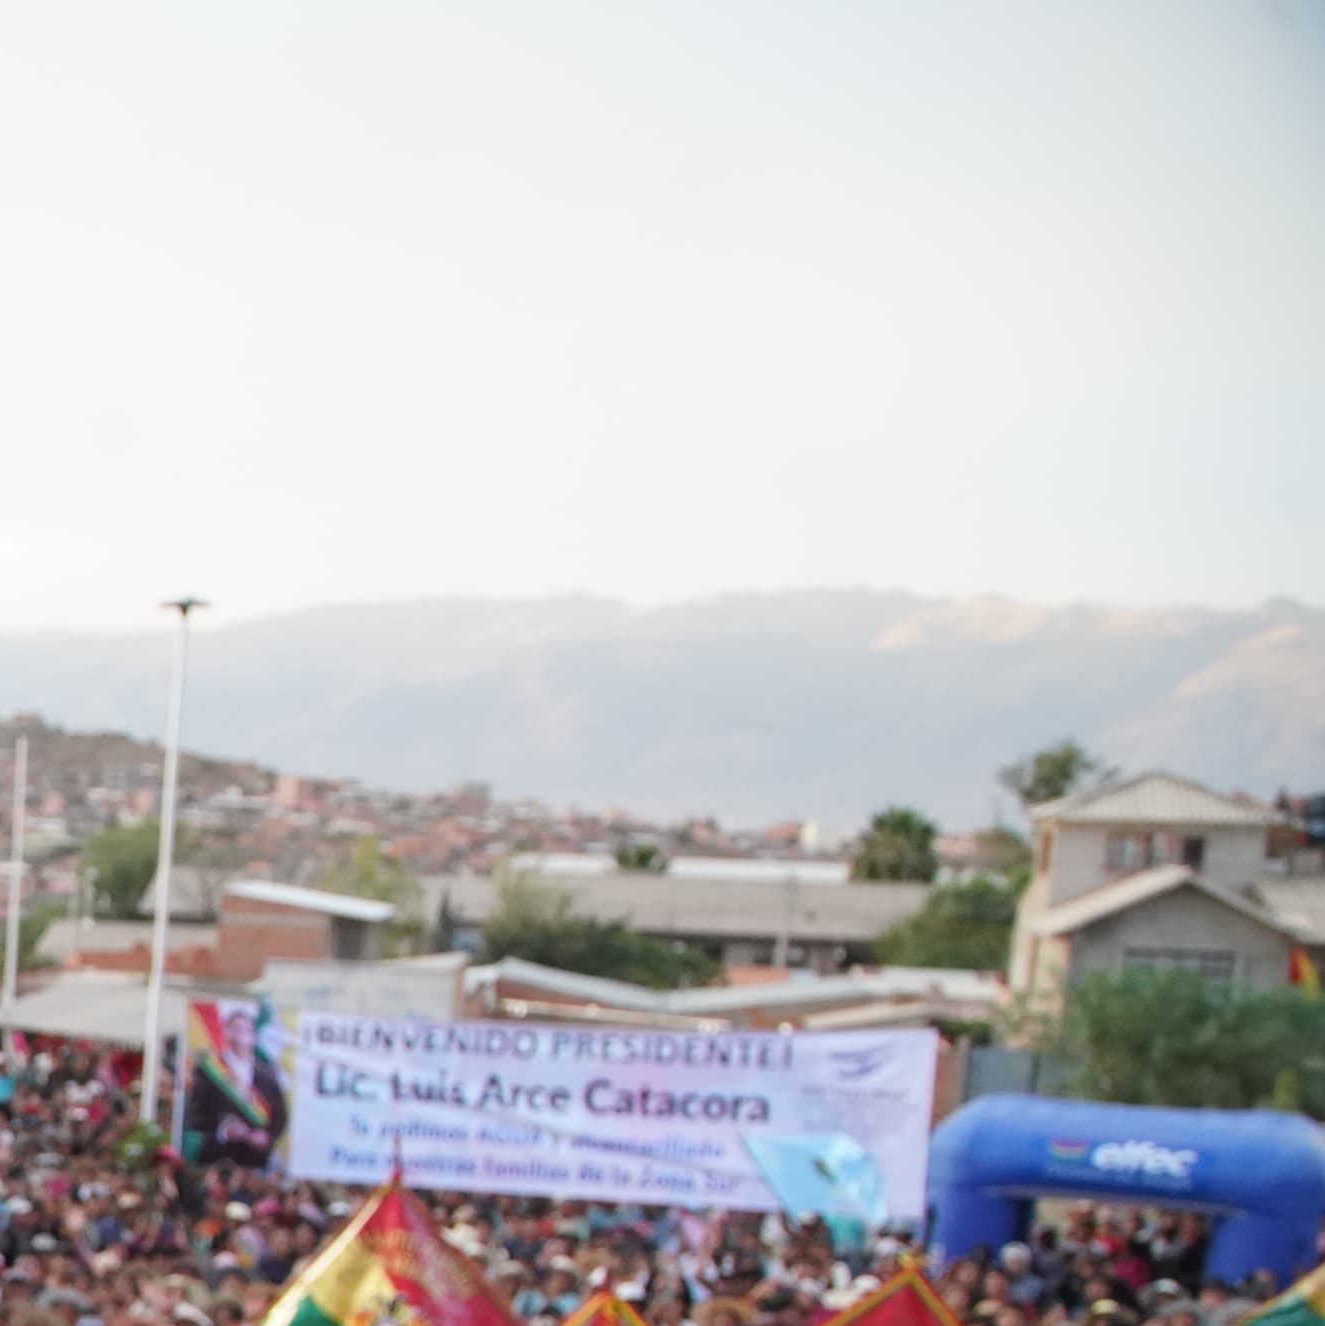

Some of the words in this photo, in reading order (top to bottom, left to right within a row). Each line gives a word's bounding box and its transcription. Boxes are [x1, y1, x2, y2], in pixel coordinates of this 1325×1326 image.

[390, 1067, 466, 1106] Luis
[477, 1073, 571, 1111] Arce
[583, 1077, 772, 1123] Catacora
